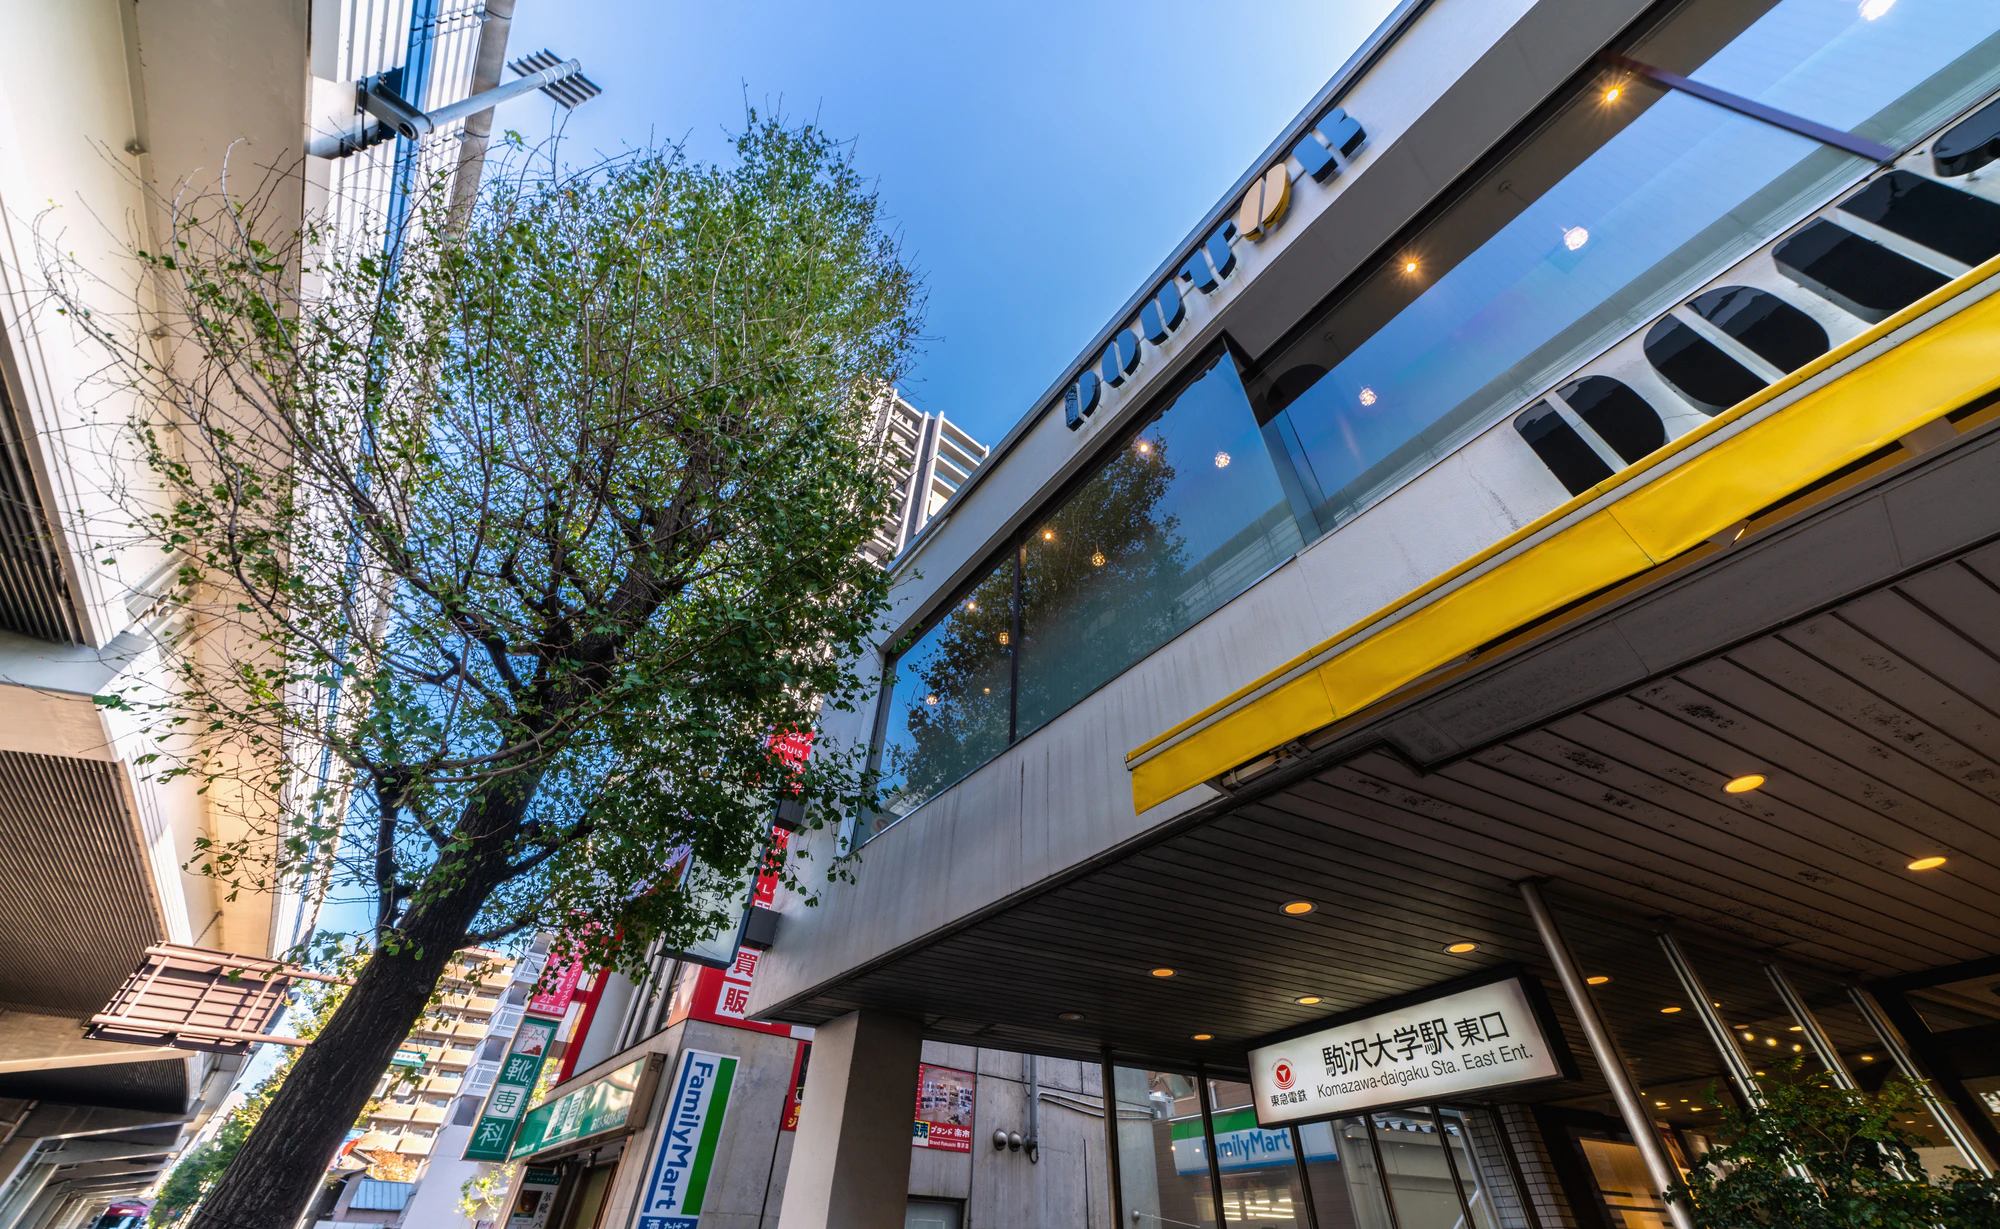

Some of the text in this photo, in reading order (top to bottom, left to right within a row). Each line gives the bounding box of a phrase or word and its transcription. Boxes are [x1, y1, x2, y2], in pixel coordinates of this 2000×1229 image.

[774, 742, 803, 758] OUIS
[539, 993, 556, 1004] 2F
[1321, 1011, 1511, 1077] 駒沢大学駅 東口
[1317, 1043, 1534, 1099] Komazawa-daigaku Sta. East Ent.
[478, 1057, 533, 1148] 靴専科
[1270, 1089, 1308, 1107] 東急電鉄
[655, 1060, 714, 1211] FamilyMart
[931, 1125, 953, 1136] ブランド
